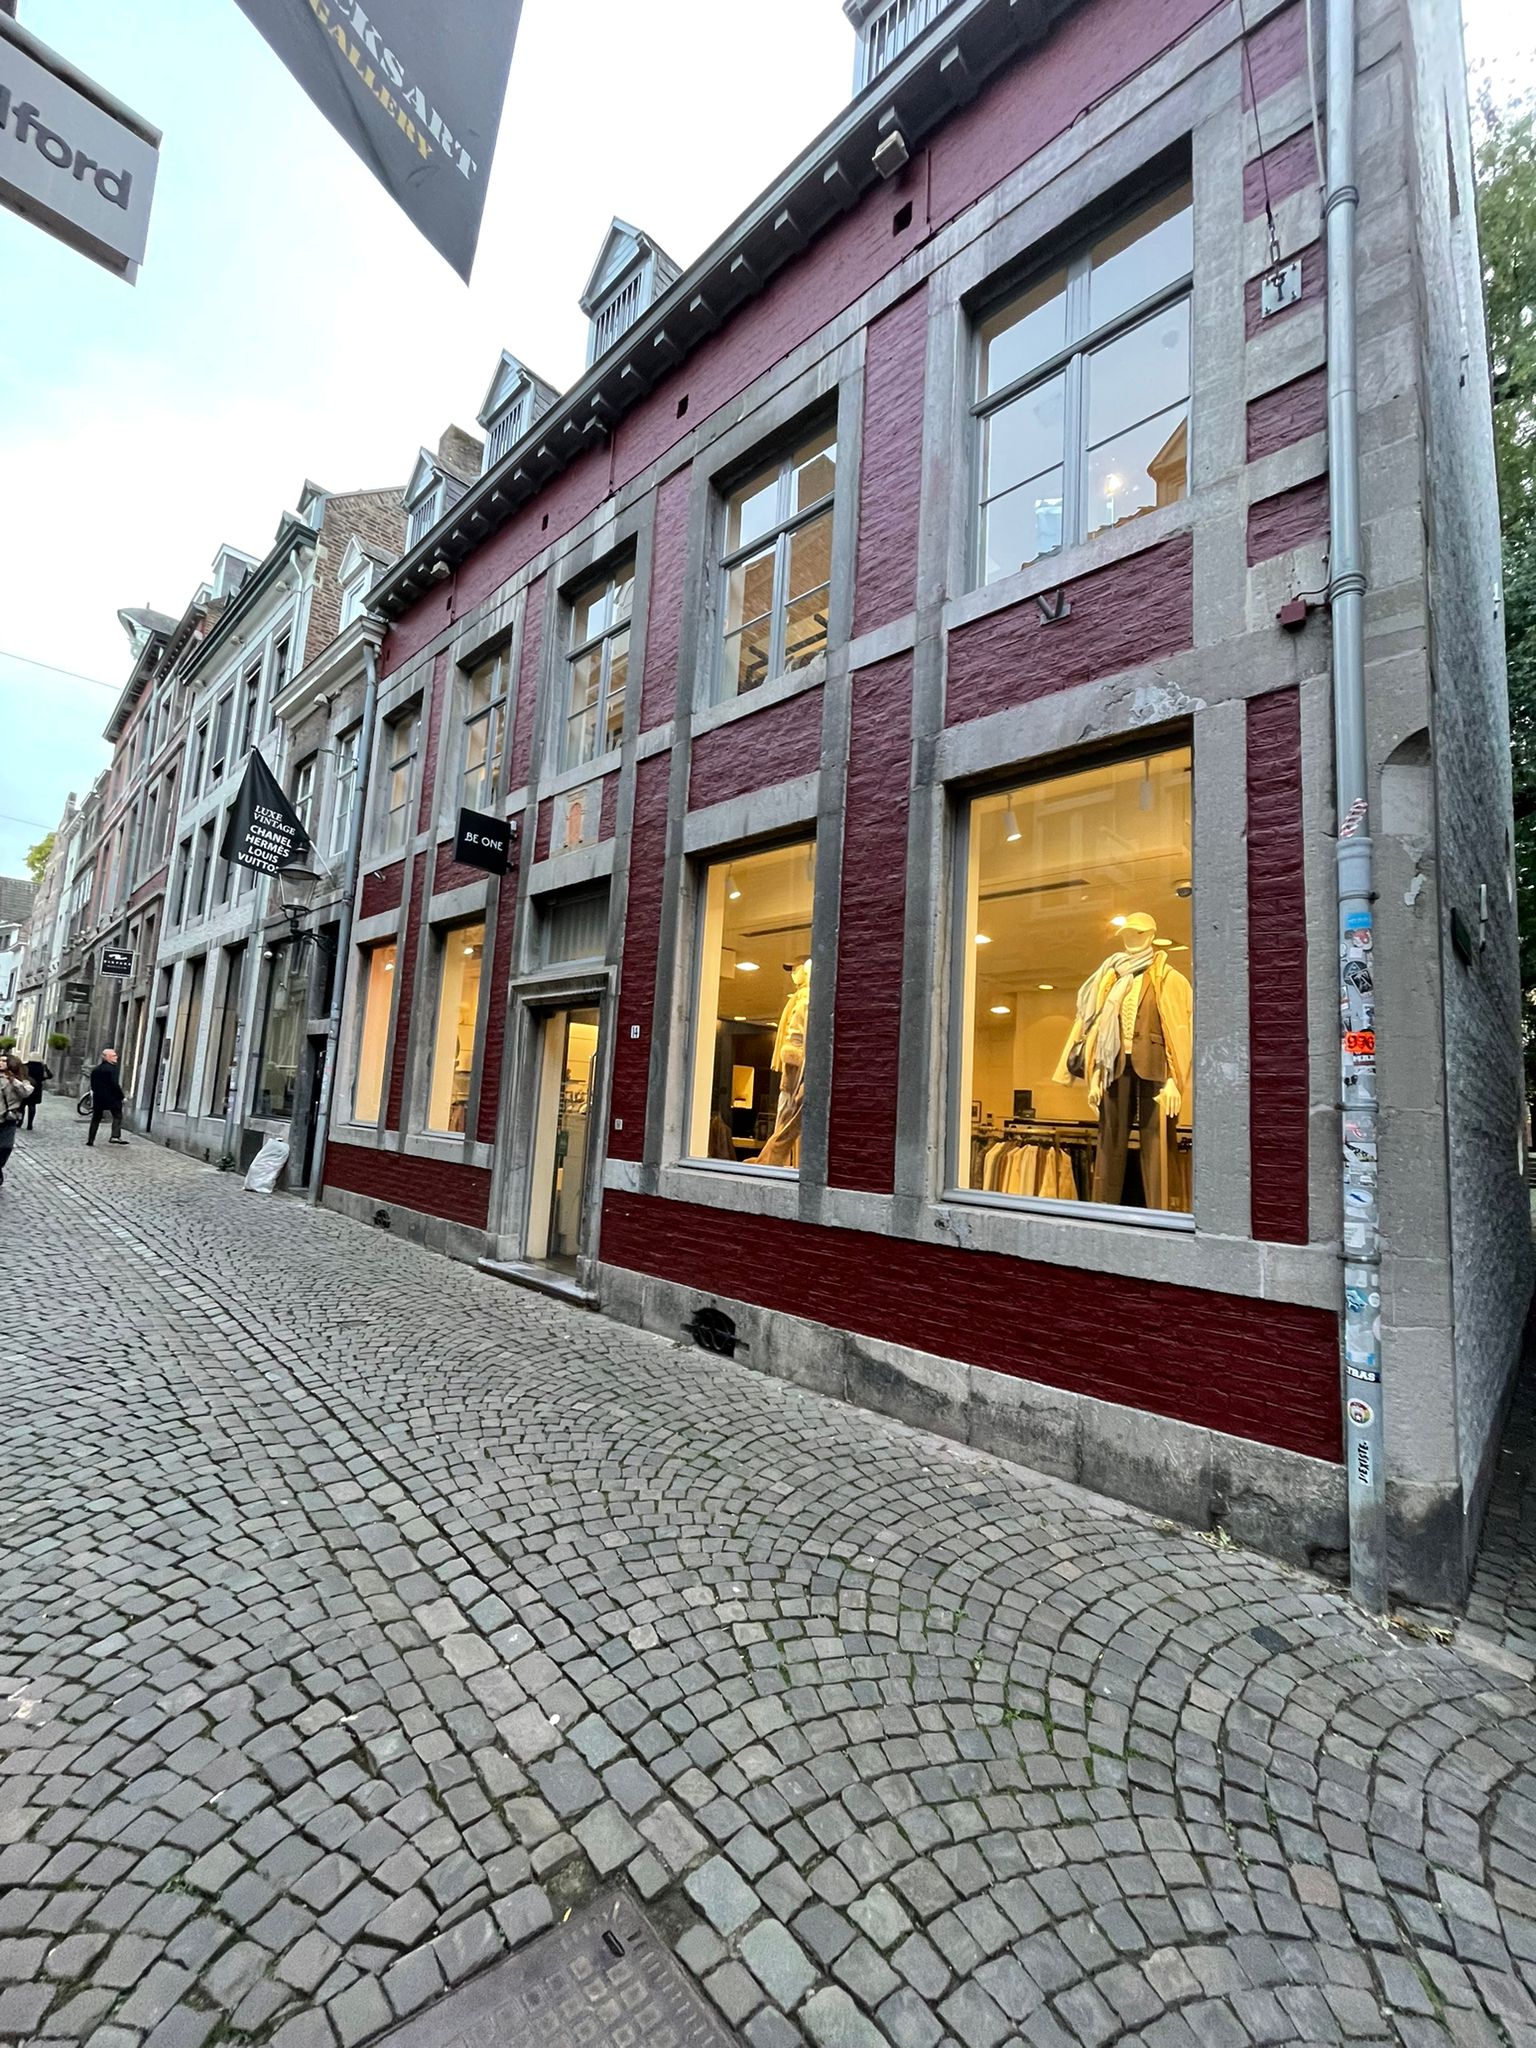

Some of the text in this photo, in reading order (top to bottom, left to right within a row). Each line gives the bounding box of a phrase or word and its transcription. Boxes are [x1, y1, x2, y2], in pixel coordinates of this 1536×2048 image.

[253, 812, 296, 836] VINTAGE
[254, 804, 283, 822] LUXE
[245, 833, 290, 857] HERMÈS
[250, 824, 292, 848] CHANEL
[464, 831, 503, 851] BE ONE
[248, 845, 279, 863] LOUIS
